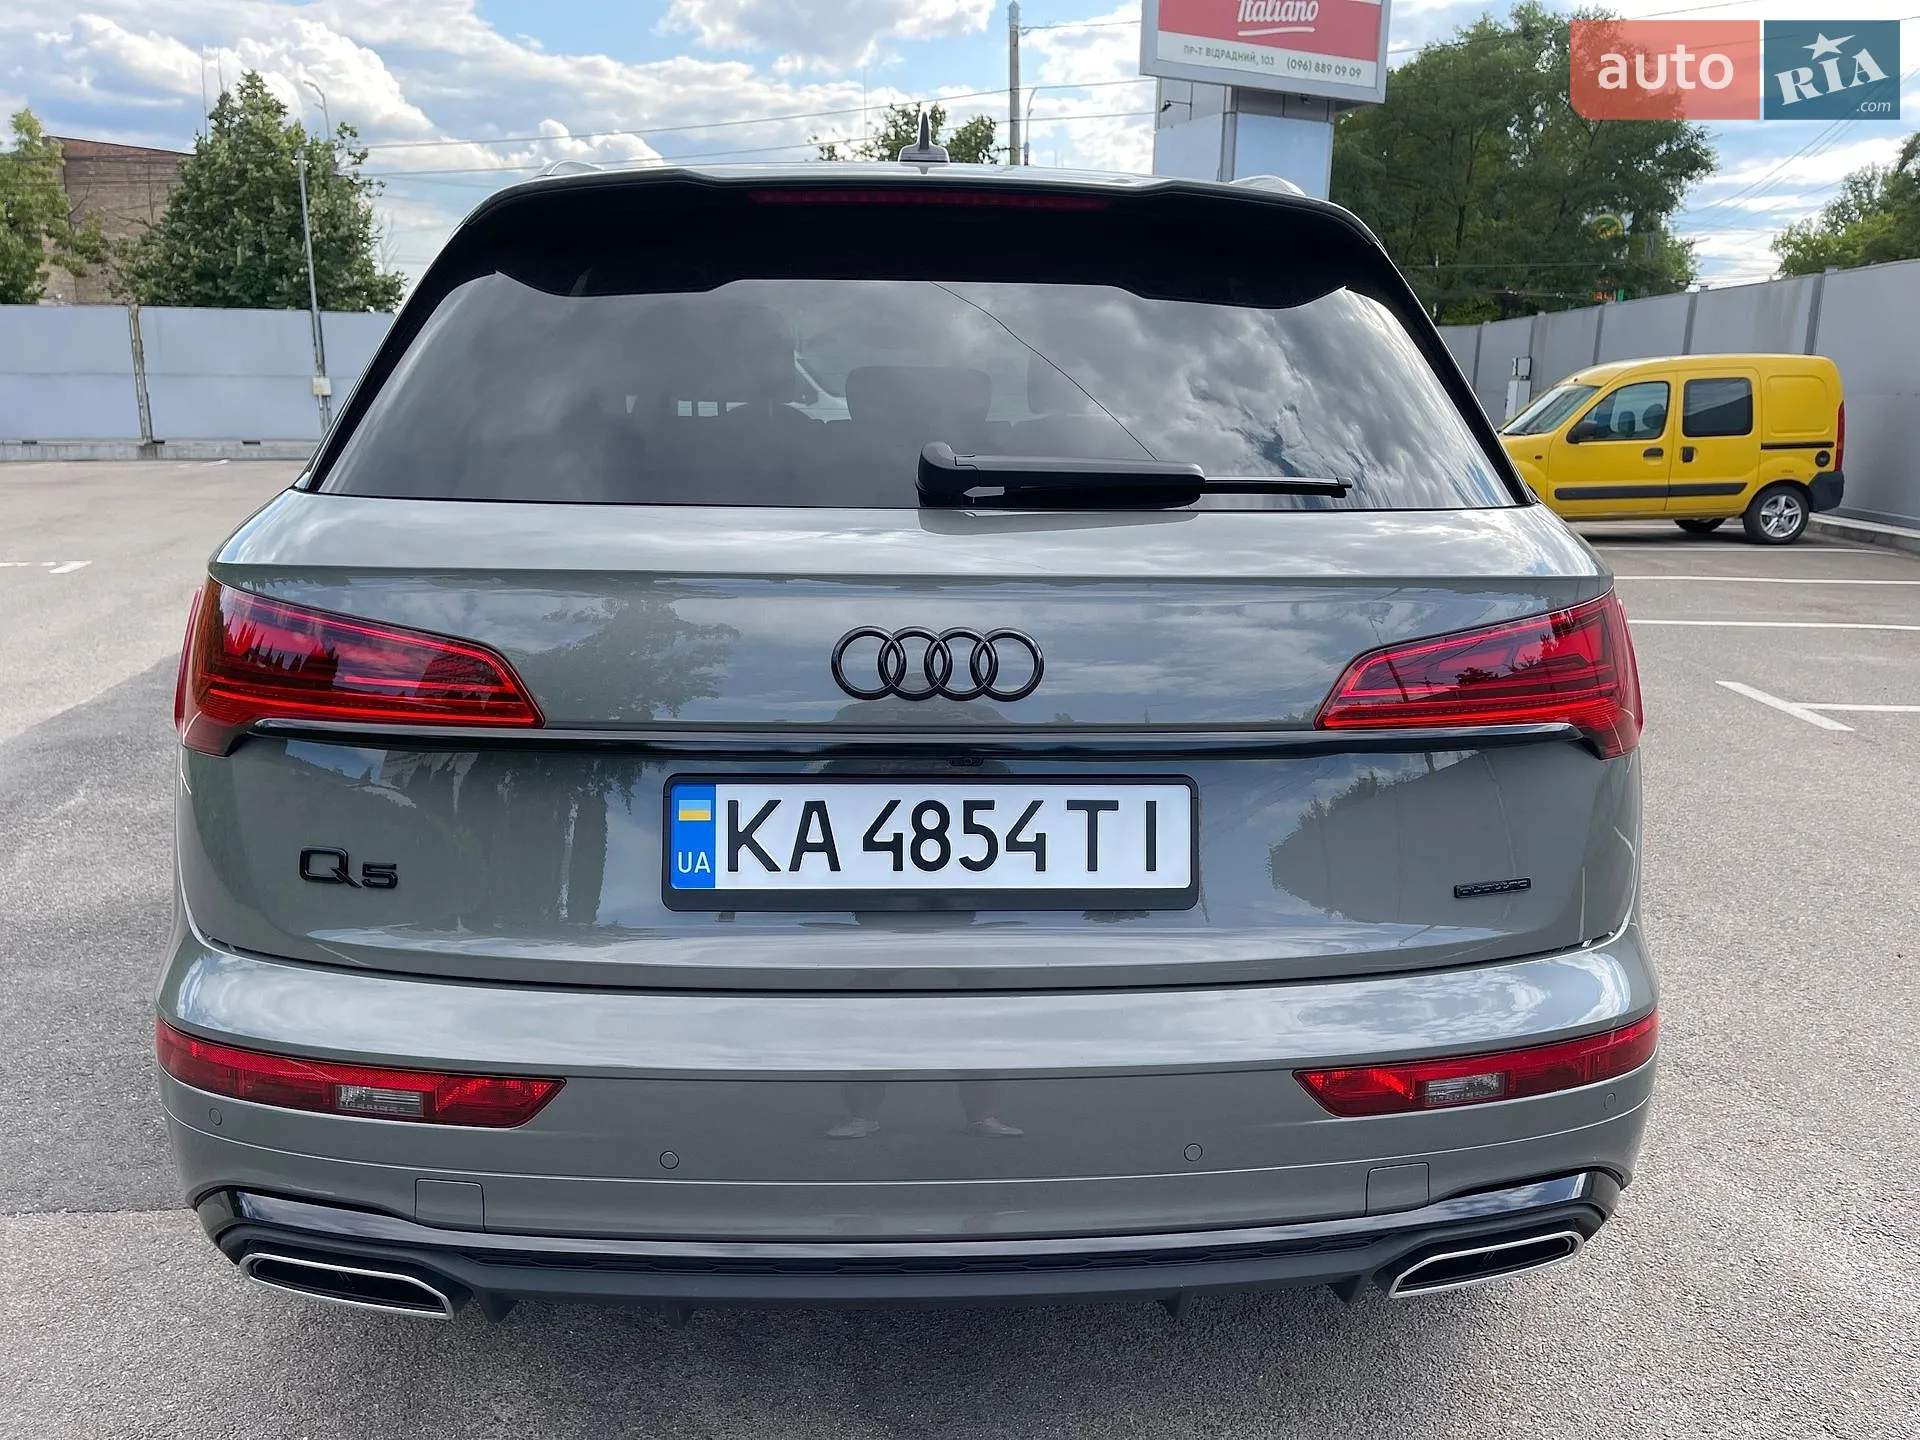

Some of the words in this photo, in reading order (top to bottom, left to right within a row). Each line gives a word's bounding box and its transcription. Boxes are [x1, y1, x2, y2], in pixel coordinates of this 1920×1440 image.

[1260, 55, 1275, 66] 103
[1287, 56, 1312, 73] (096)
[1334, 65, 1347, 76] 09
[1348, 67, 1361, 78] 09
[727, 799, 841, 872] KA
[862, 799, 1046, 872] 4854
[1066, 799, 1157, 872] TI
[299, 845, 399, 889] Q5
[678, 851, 711, 874] UA
